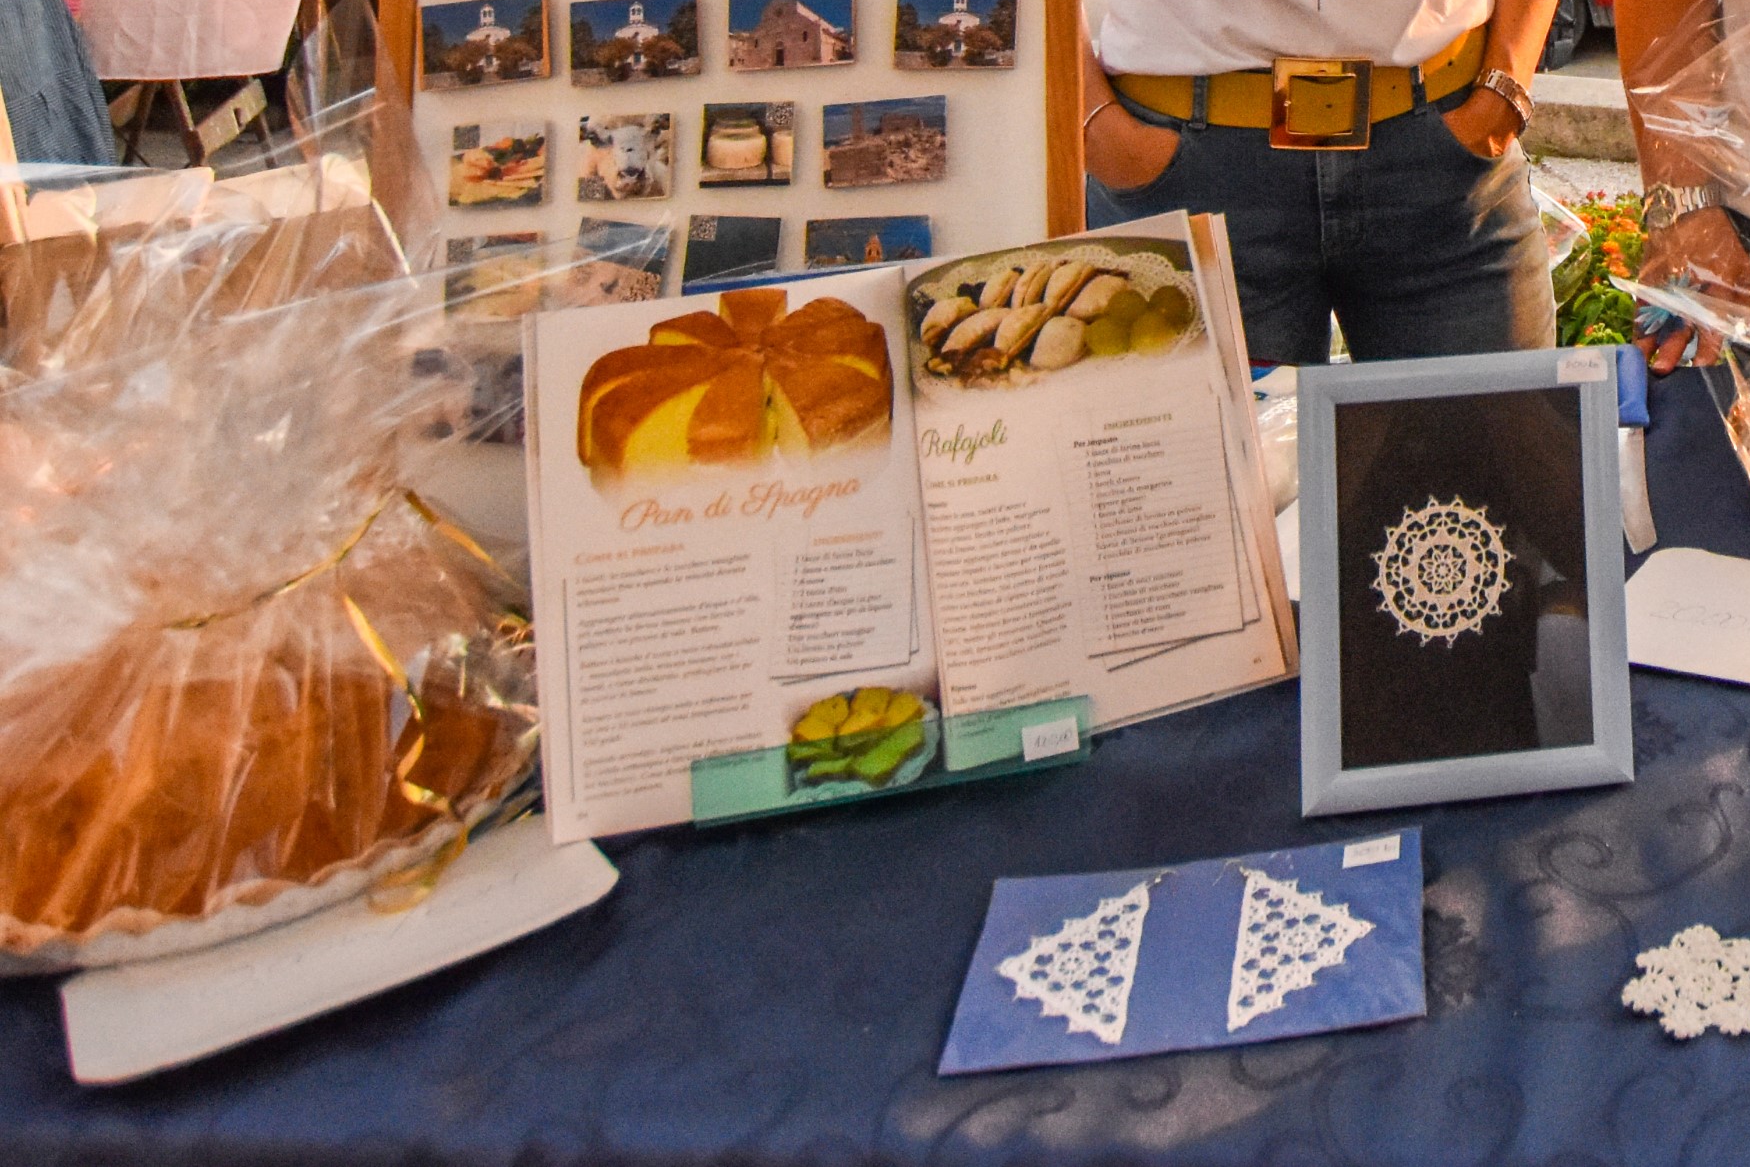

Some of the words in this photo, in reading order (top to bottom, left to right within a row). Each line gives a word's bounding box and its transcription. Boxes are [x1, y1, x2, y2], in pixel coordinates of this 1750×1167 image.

[921, 419, 1008, 464] Rafajoli
[621, 498, 694, 531] Pan
[704, 490, 732, 519] di
[740, 478, 861, 520] Spagna
